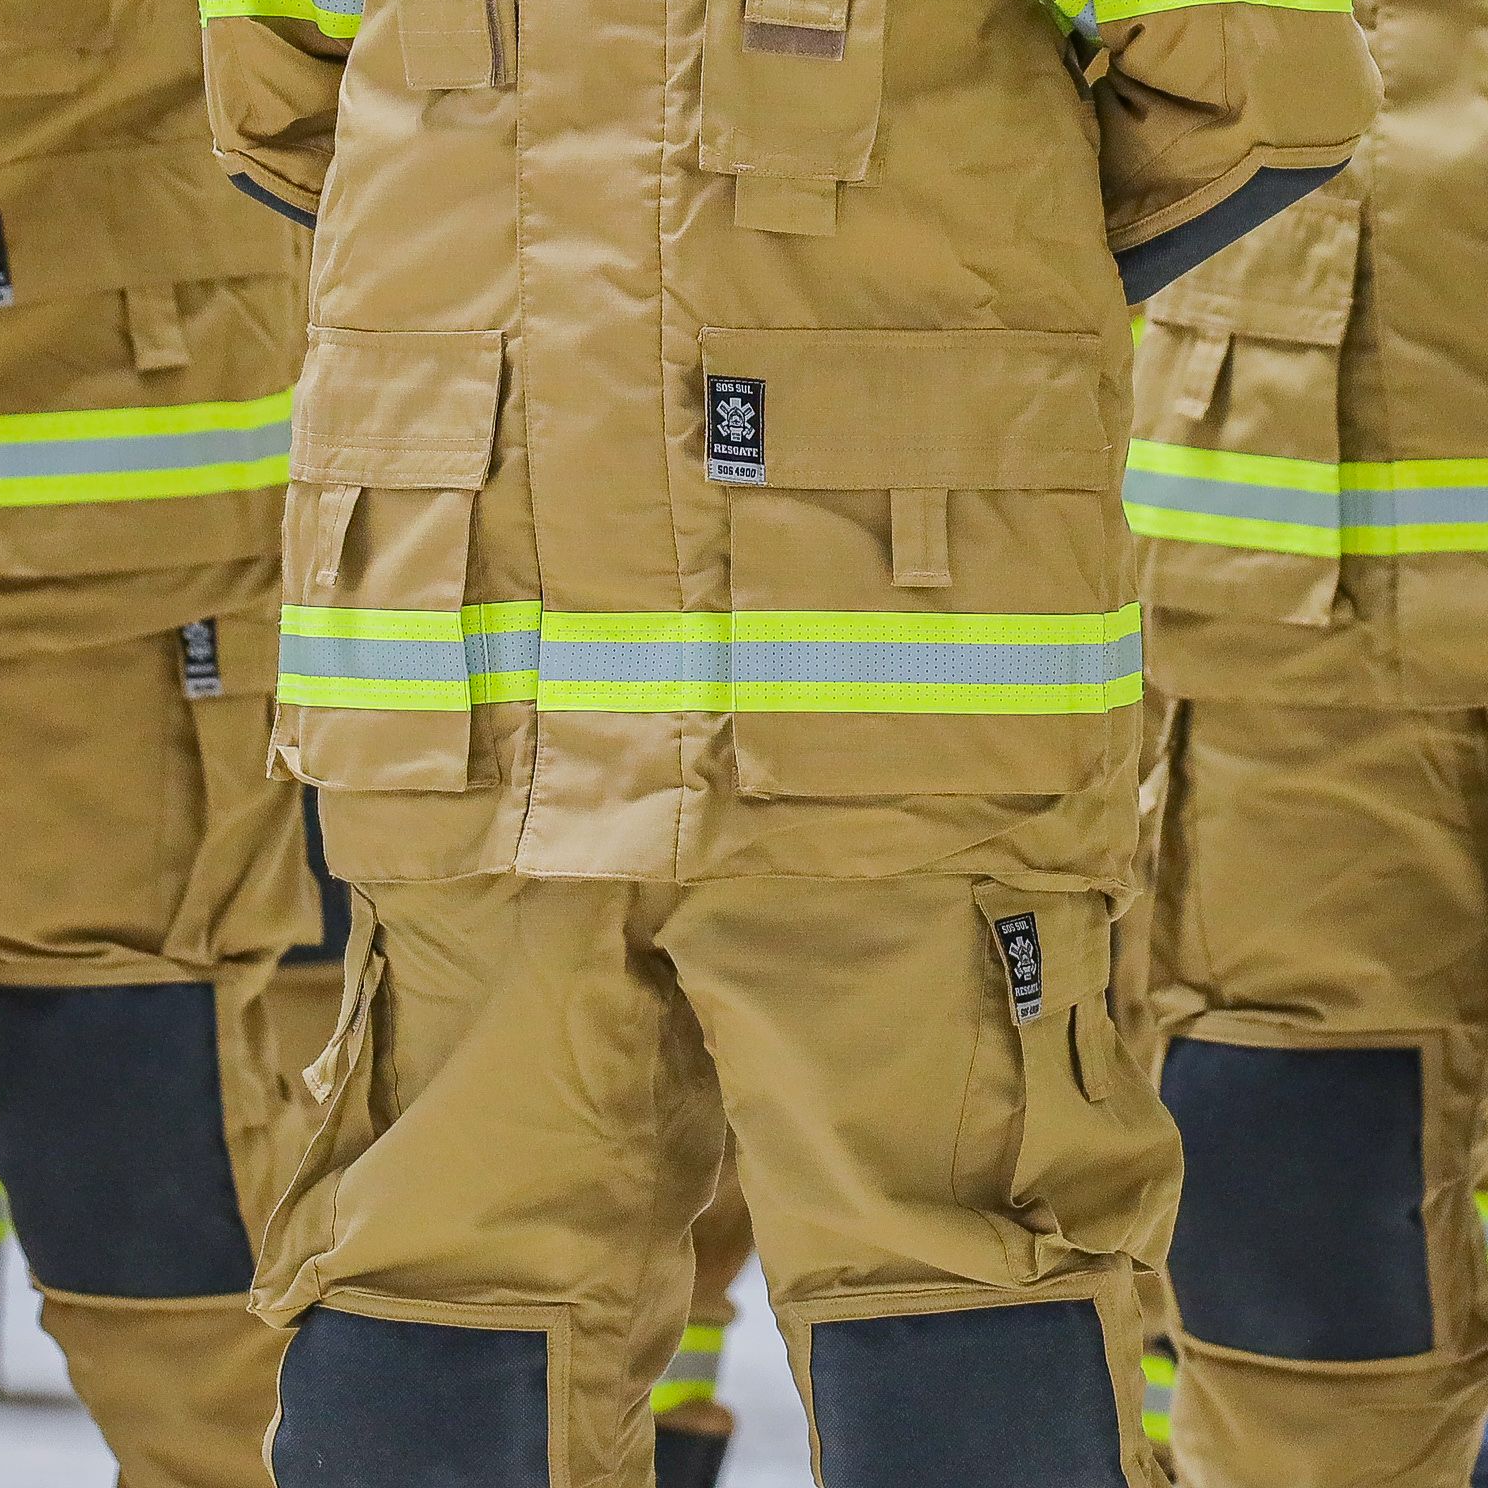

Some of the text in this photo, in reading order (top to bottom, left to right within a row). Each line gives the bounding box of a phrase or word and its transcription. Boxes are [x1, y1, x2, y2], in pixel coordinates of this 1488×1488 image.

[716, 383, 754, 394] SOS SUL
[713, 443, 759, 458] RESGATE
[718, 464, 757, 478] SOS 4900
[1015, 920, 1029, 931] SUL
